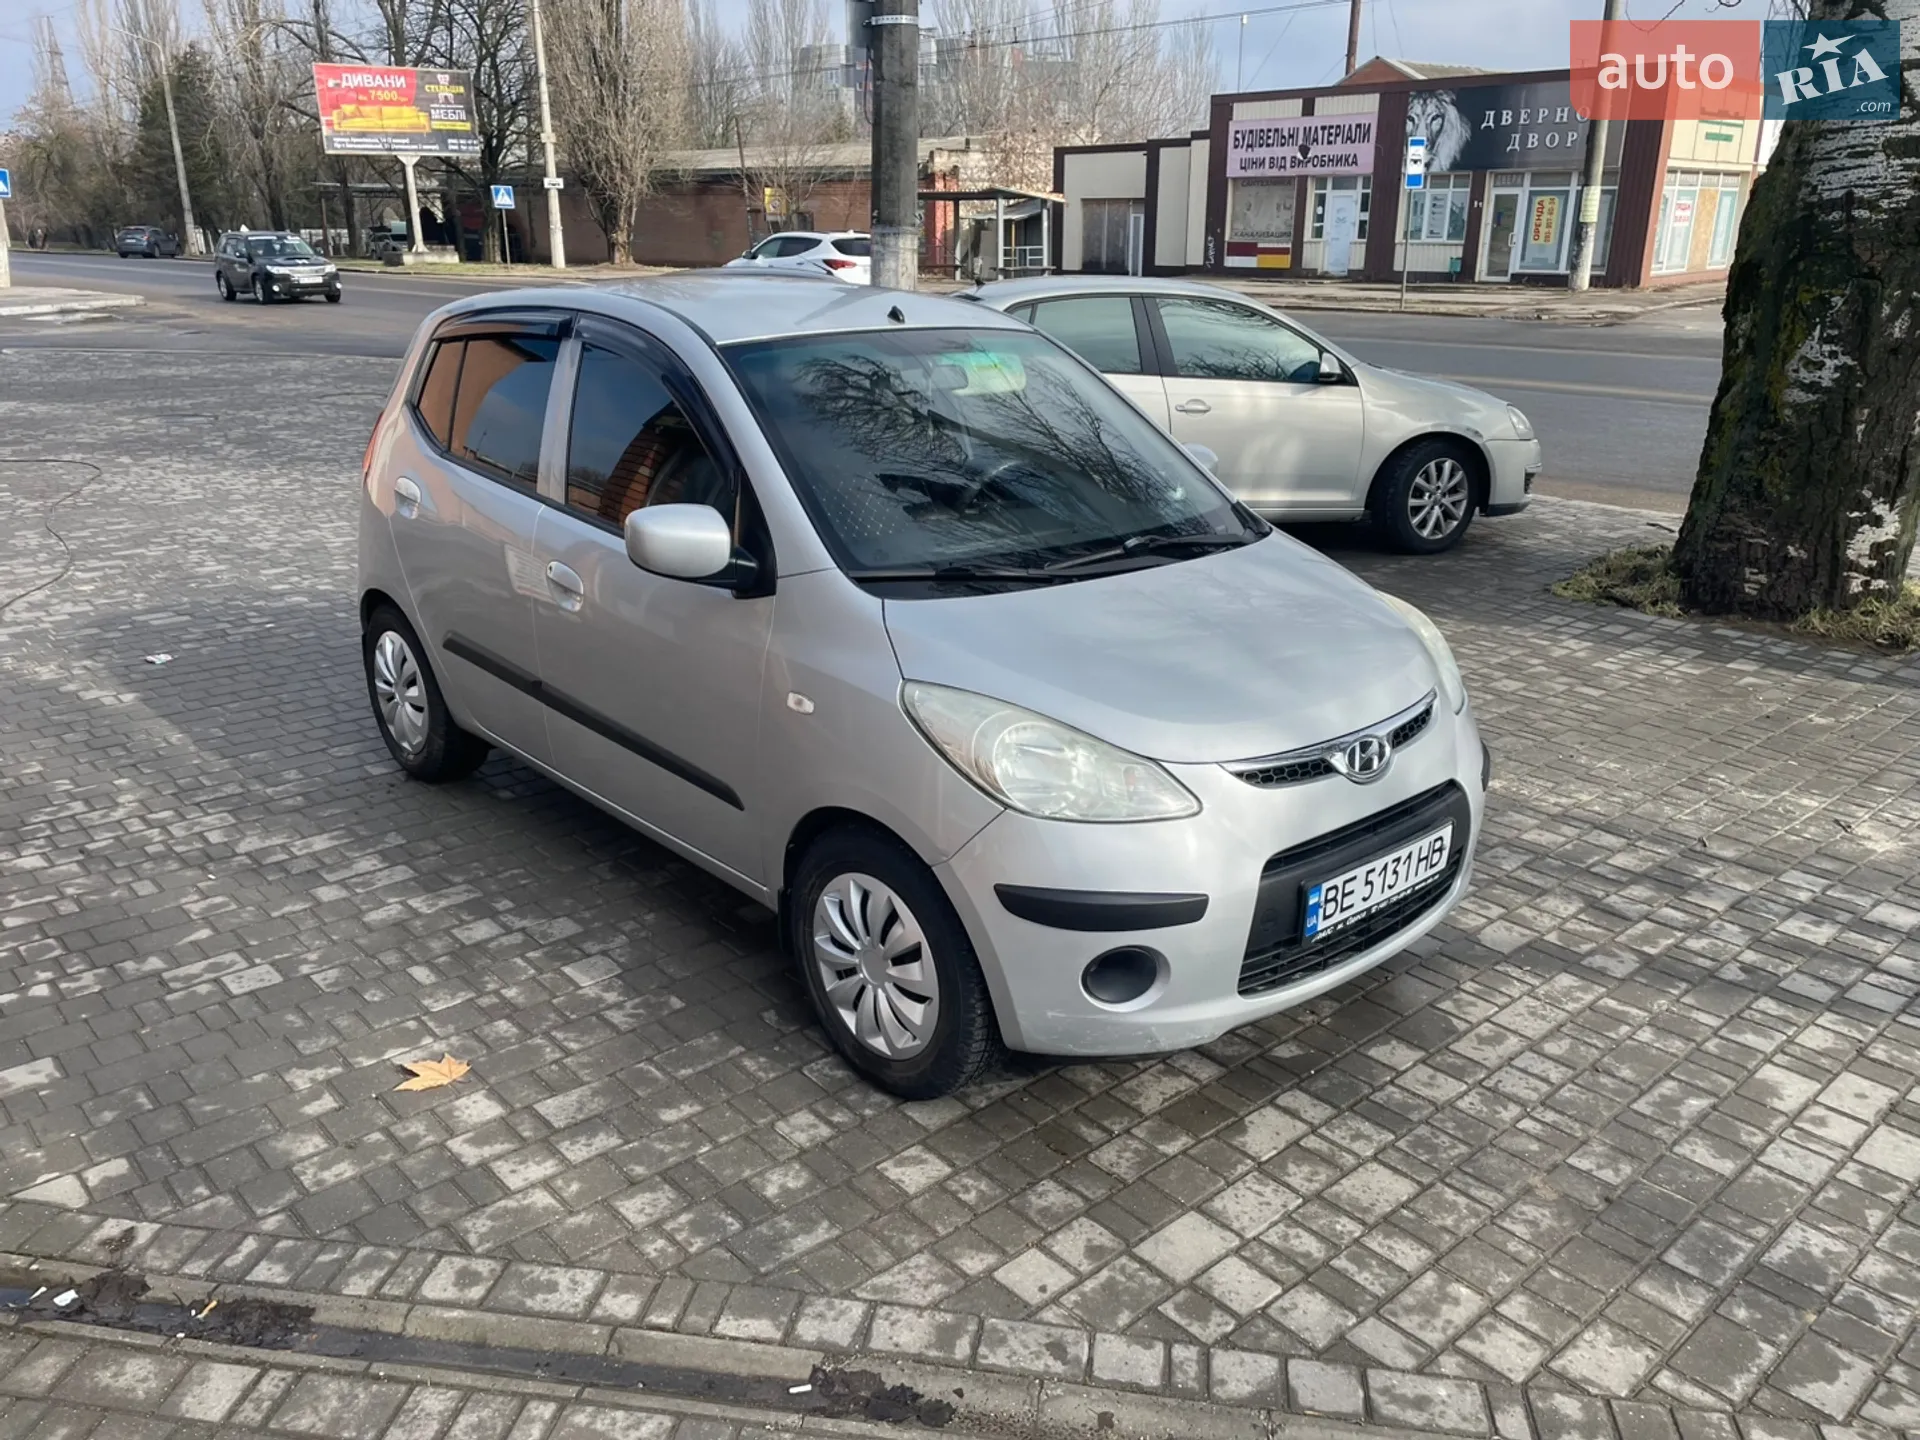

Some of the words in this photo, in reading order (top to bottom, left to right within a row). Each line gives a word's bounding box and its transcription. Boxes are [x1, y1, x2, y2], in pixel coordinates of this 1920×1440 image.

[341, 73, 407, 89] ДИВАНИ
[368, 90, 399, 101] 7500
[1480, 106, 1591, 130] ДВЕРНО
[1233, 127, 1299, 152] БУДІВЕЛЬНІ
[1302, 123, 1371, 146] МАТЕРІАЛИ
[1506, 131, 1578, 153] ДВОР
[1239, 157, 1266, 171] ЦІНИ
[1269, 156, 1287, 171] ВІД
[1533, 200, 1544, 242] ОРЕНДА
